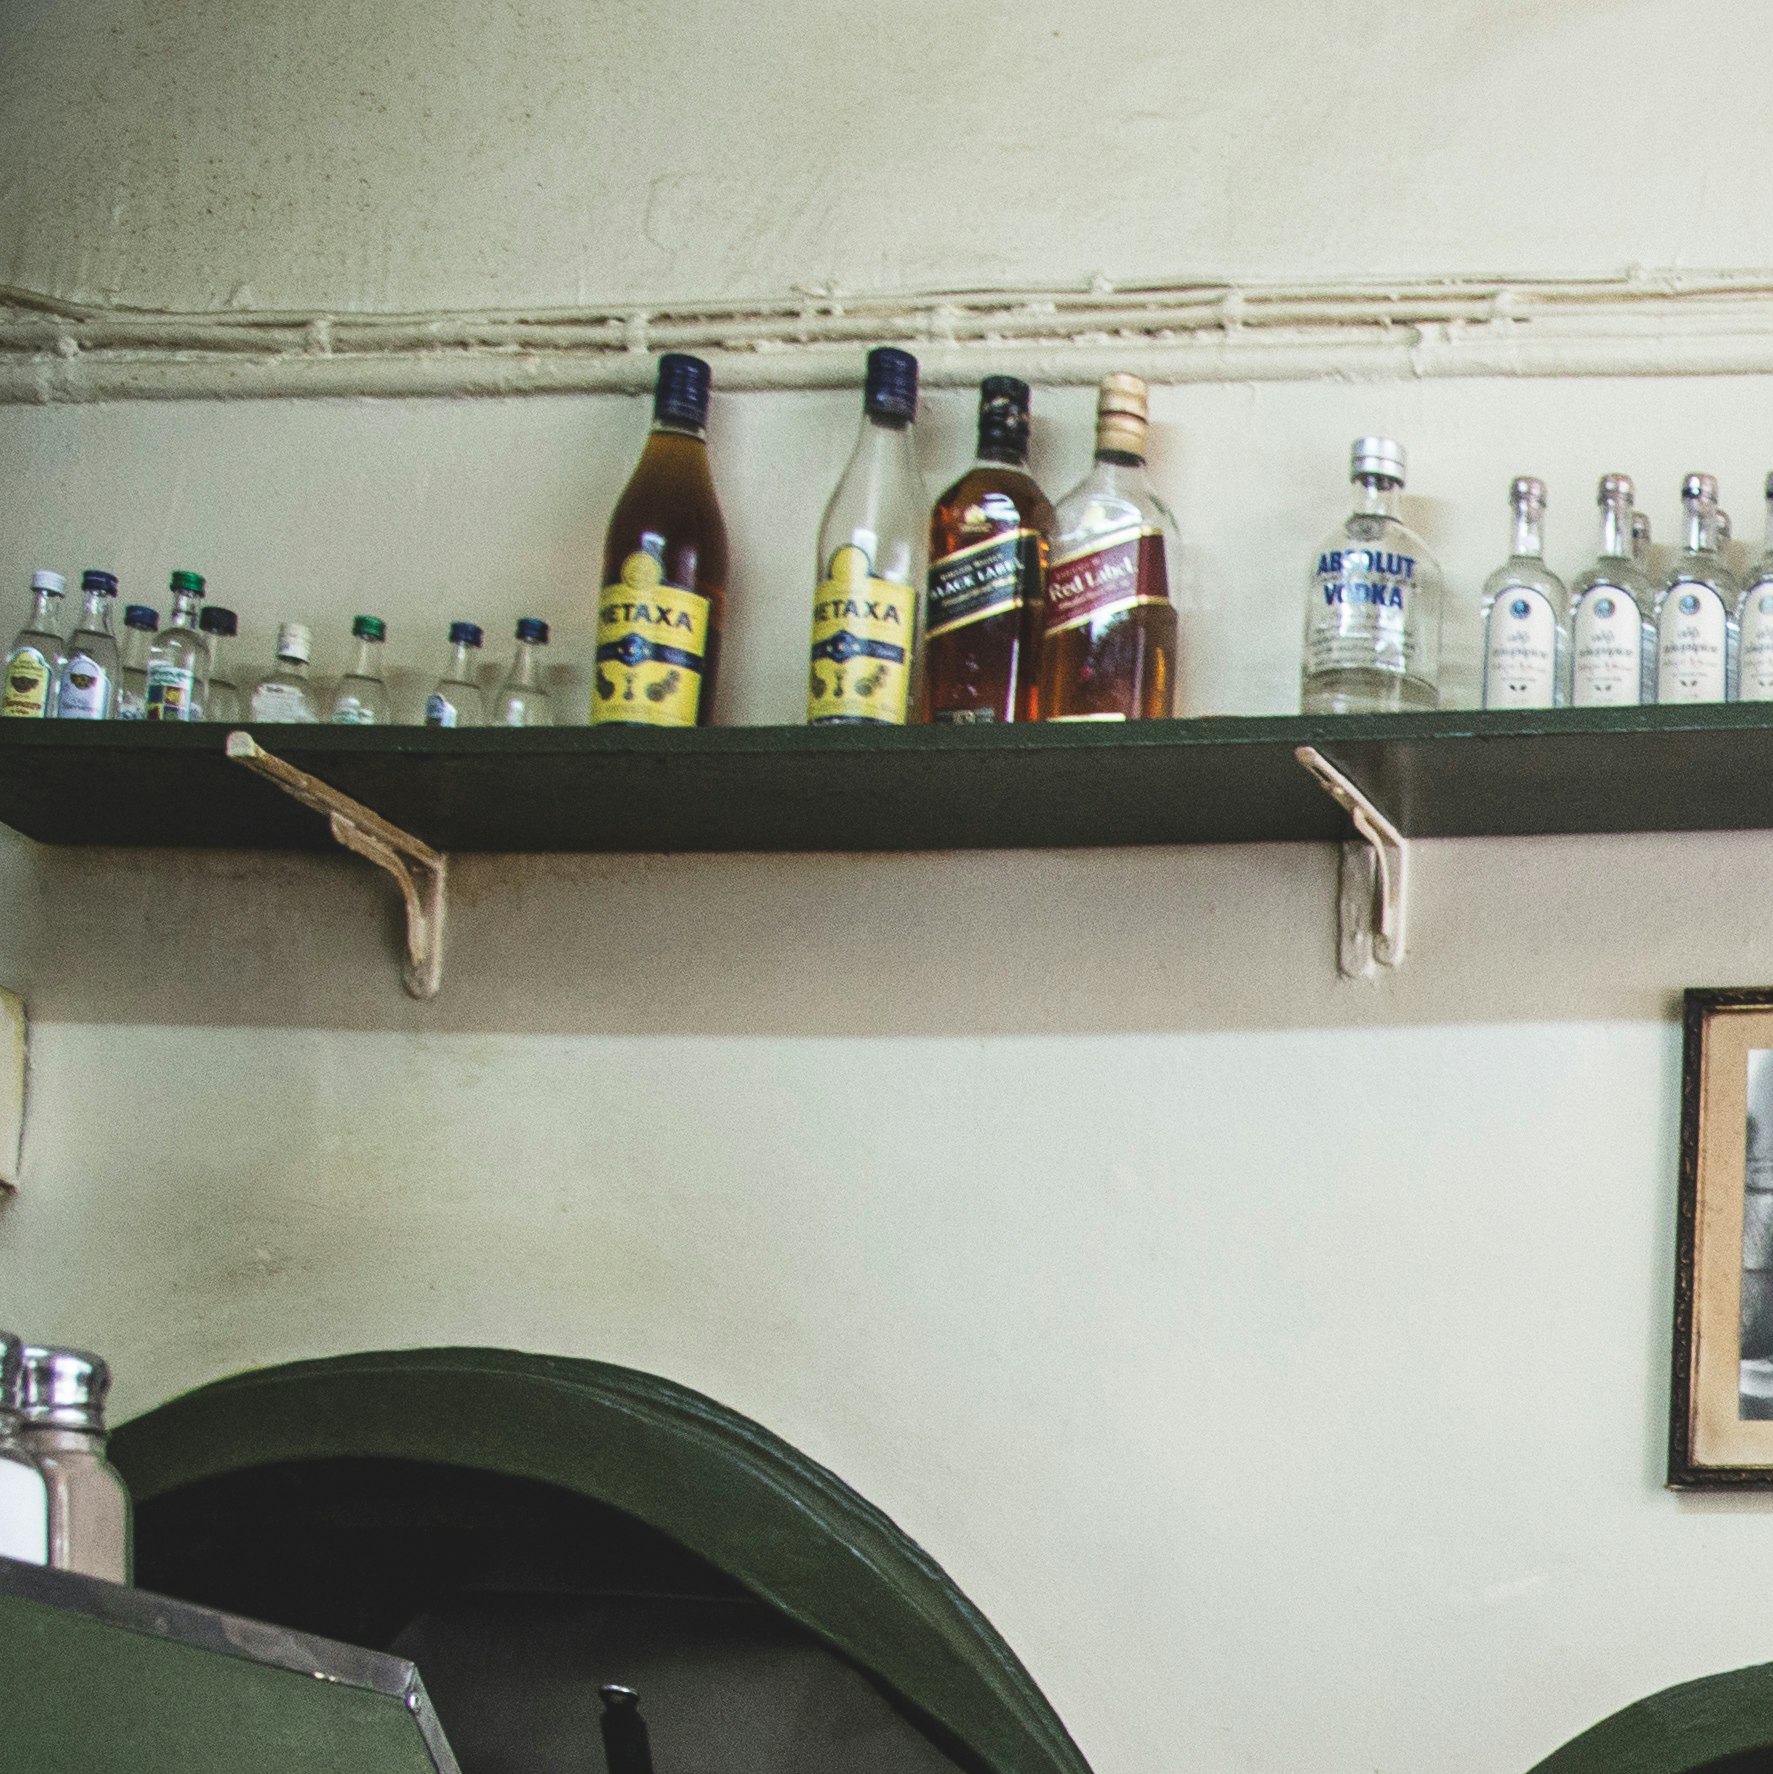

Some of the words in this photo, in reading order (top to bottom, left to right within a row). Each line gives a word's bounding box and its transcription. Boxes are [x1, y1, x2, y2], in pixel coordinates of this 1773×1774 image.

[1050, 573, 1085, 601] Red
[1086, 556, 1139, 587] Label
[600, 603, 693, 633] ETAXA
[813, 599, 900, 625] ETAXA
